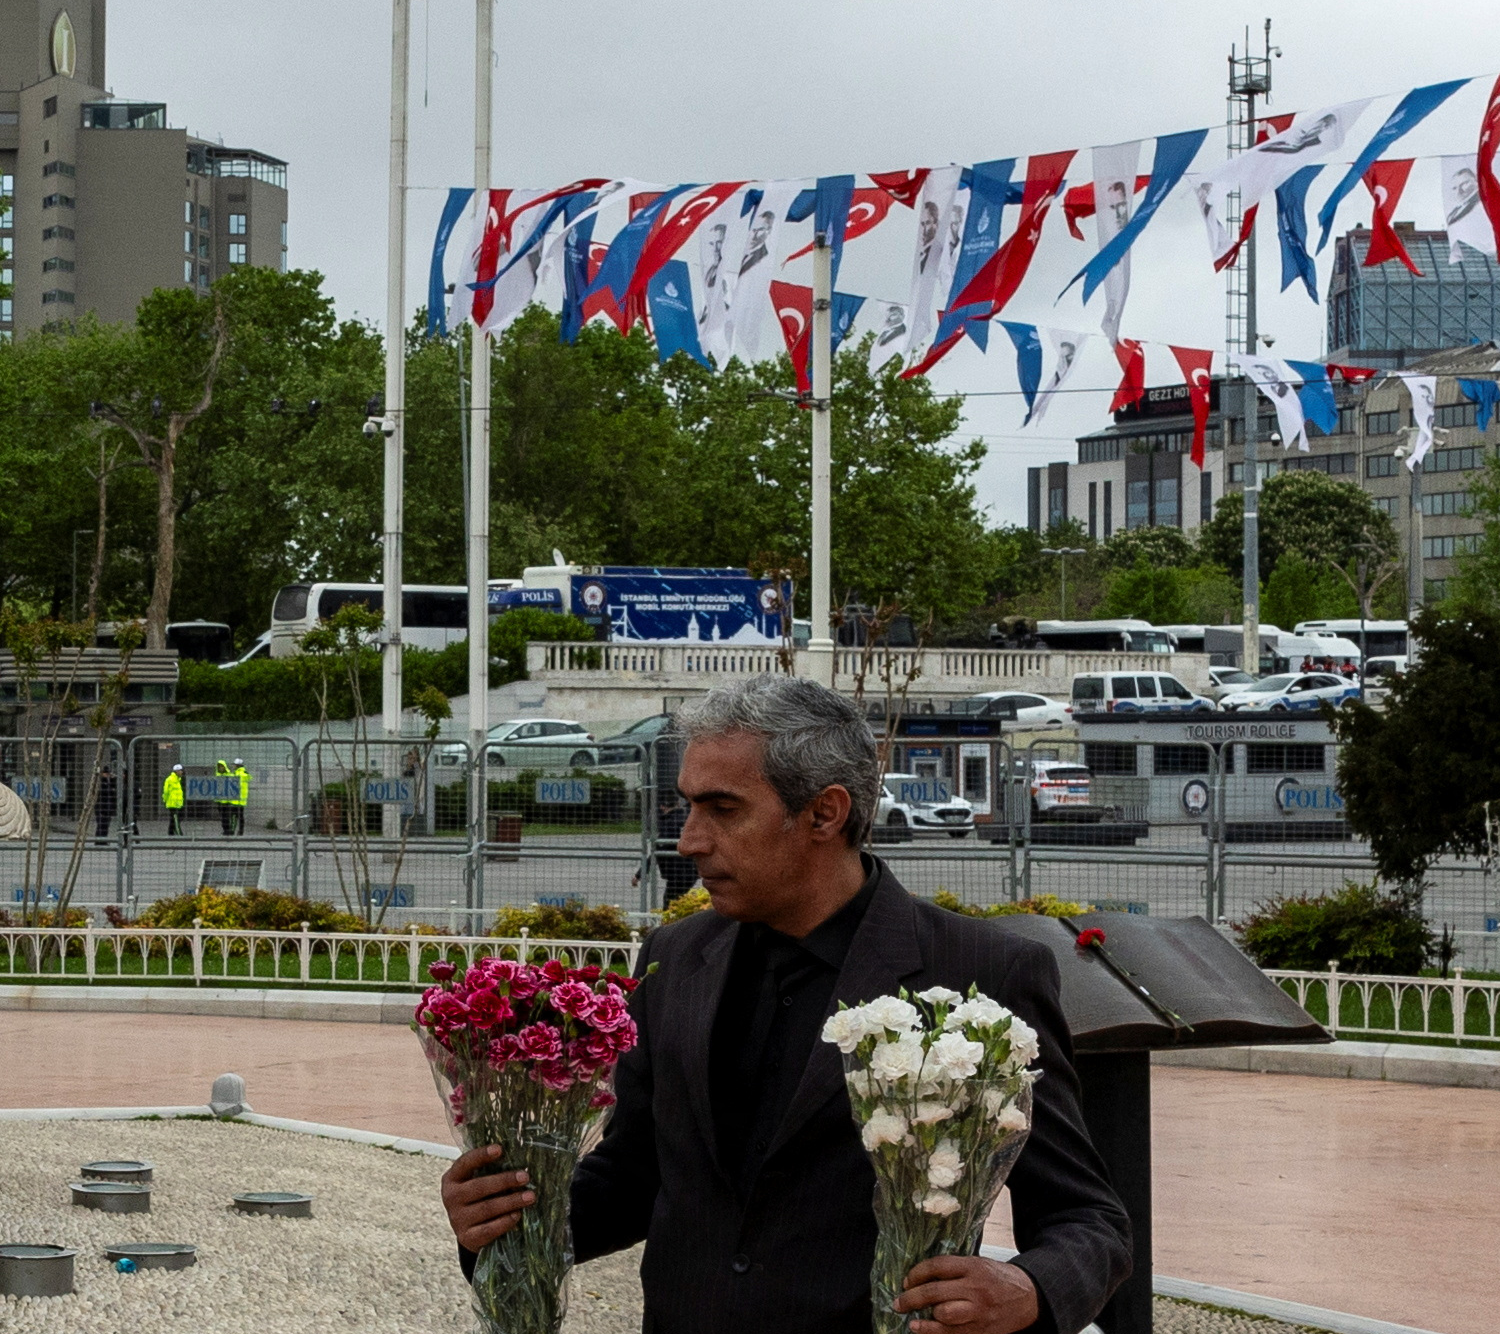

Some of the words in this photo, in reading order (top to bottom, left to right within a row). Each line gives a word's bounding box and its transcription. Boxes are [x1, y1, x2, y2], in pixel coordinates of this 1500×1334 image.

[521, 590, 555, 602] POLİS
[1187, 725, 1246, 738] TOURISM
[1249, 724, 1297, 738] POLICE
[188, 776, 240, 797] POLİS
[365, 779, 409, 801] POLİS
[541, 779, 585, 802] POLİS
[901, 778, 949, 803] POLİS
